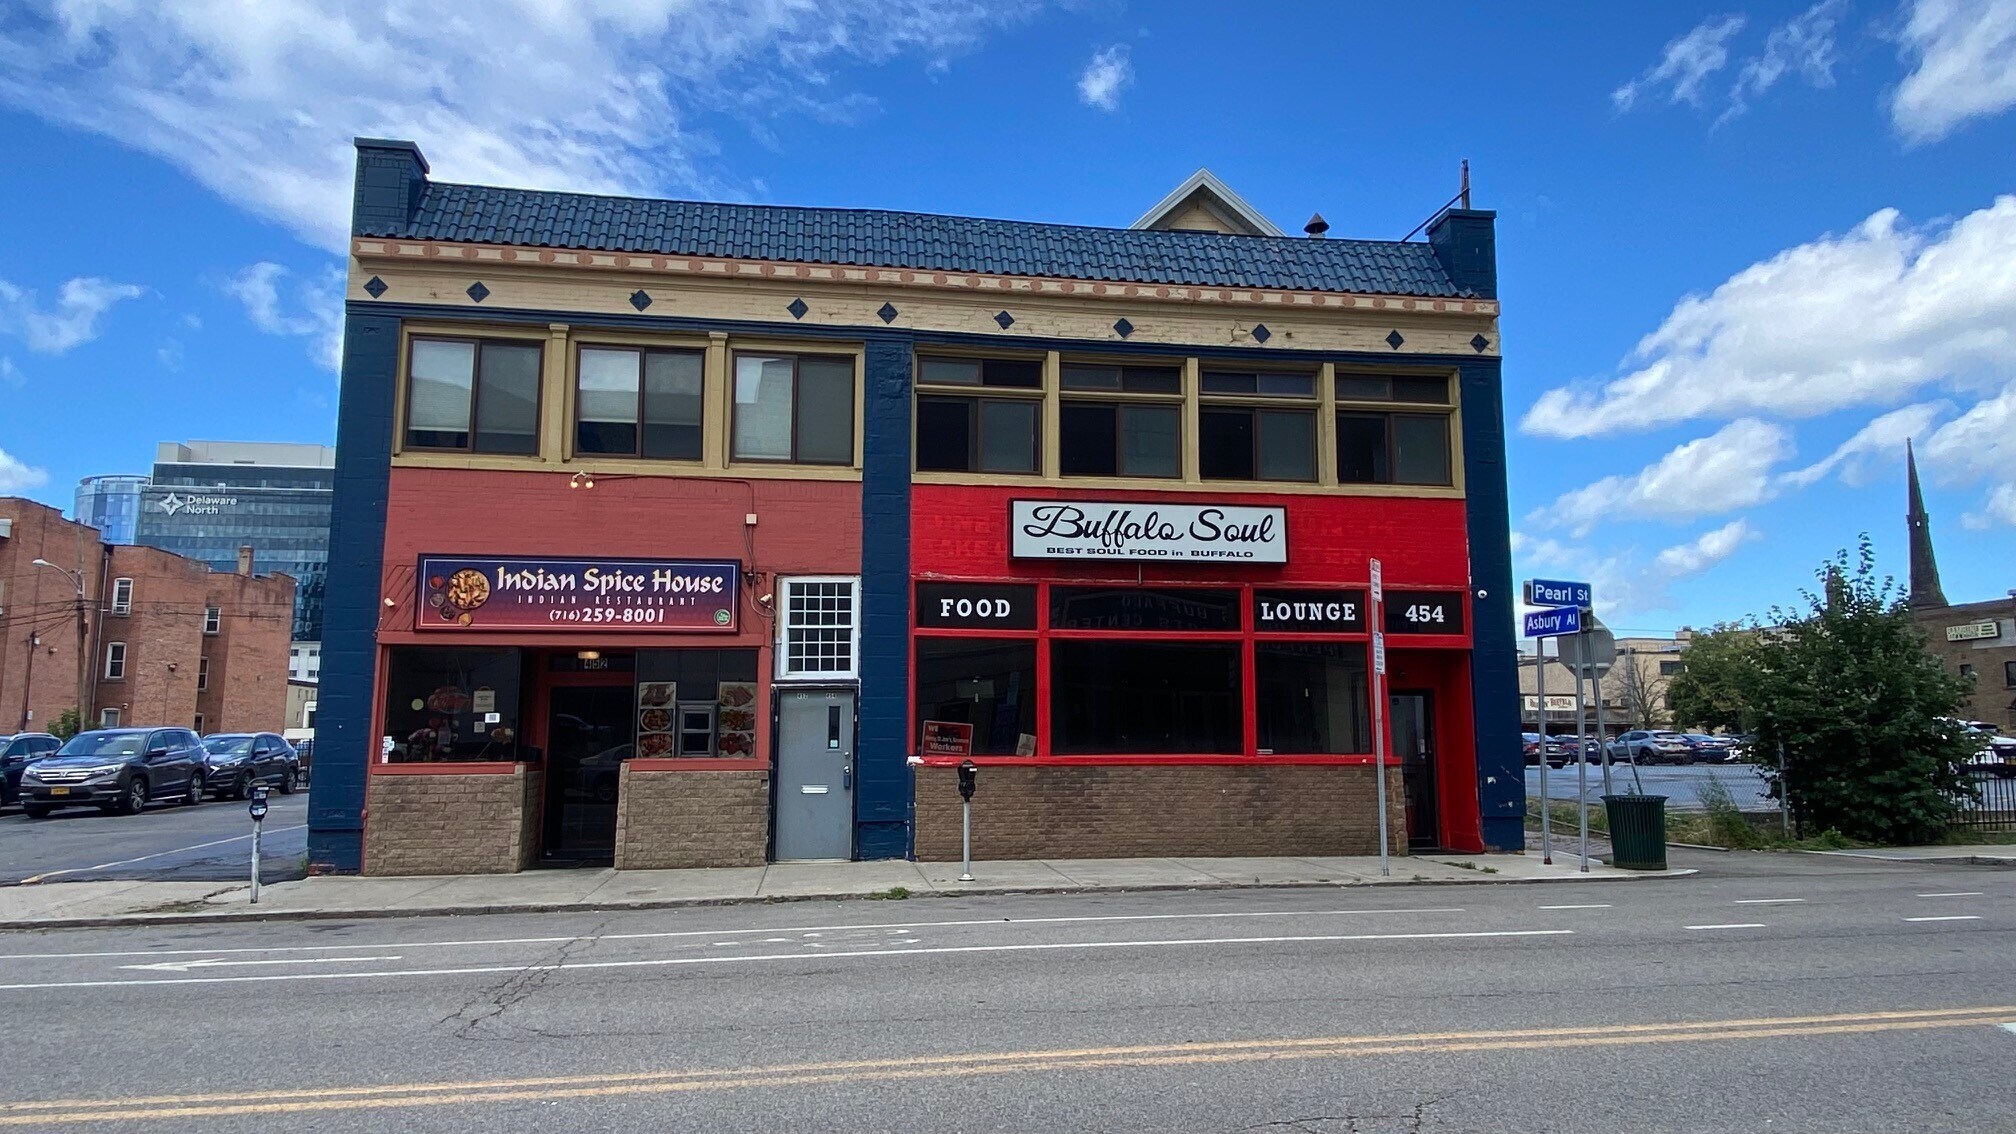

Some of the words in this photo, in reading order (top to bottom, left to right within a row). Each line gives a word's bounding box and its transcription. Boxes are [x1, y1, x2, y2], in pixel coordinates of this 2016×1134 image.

[187, 495, 238, 505] Delaware
[186, 505, 219, 514] North
[1023, 505, 1184, 547] Buffalo
[1189, 509, 1276, 543] Soul
[1190, 550, 1254, 558] BUFFALO
[497, 566, 576, 591] Indian
[583, 568, 645, 596] Spice
[651, 569, 724, 593] House
[518, 595, 577, 604] INDIAN
[596, 596, 696, 606] RESTAURANT
[1535, 584, 1571, 601] Pearl
[1577, 589, 1589, 601] St
[940, 598, 1011, 618] FOOD
[1261, 602, 1356, 621] LOUNGE
[1405, 604, 1445, 623] 454
[1527, 614, 1561, 631] Asbury
[930, 742, 963, 752] Workers
